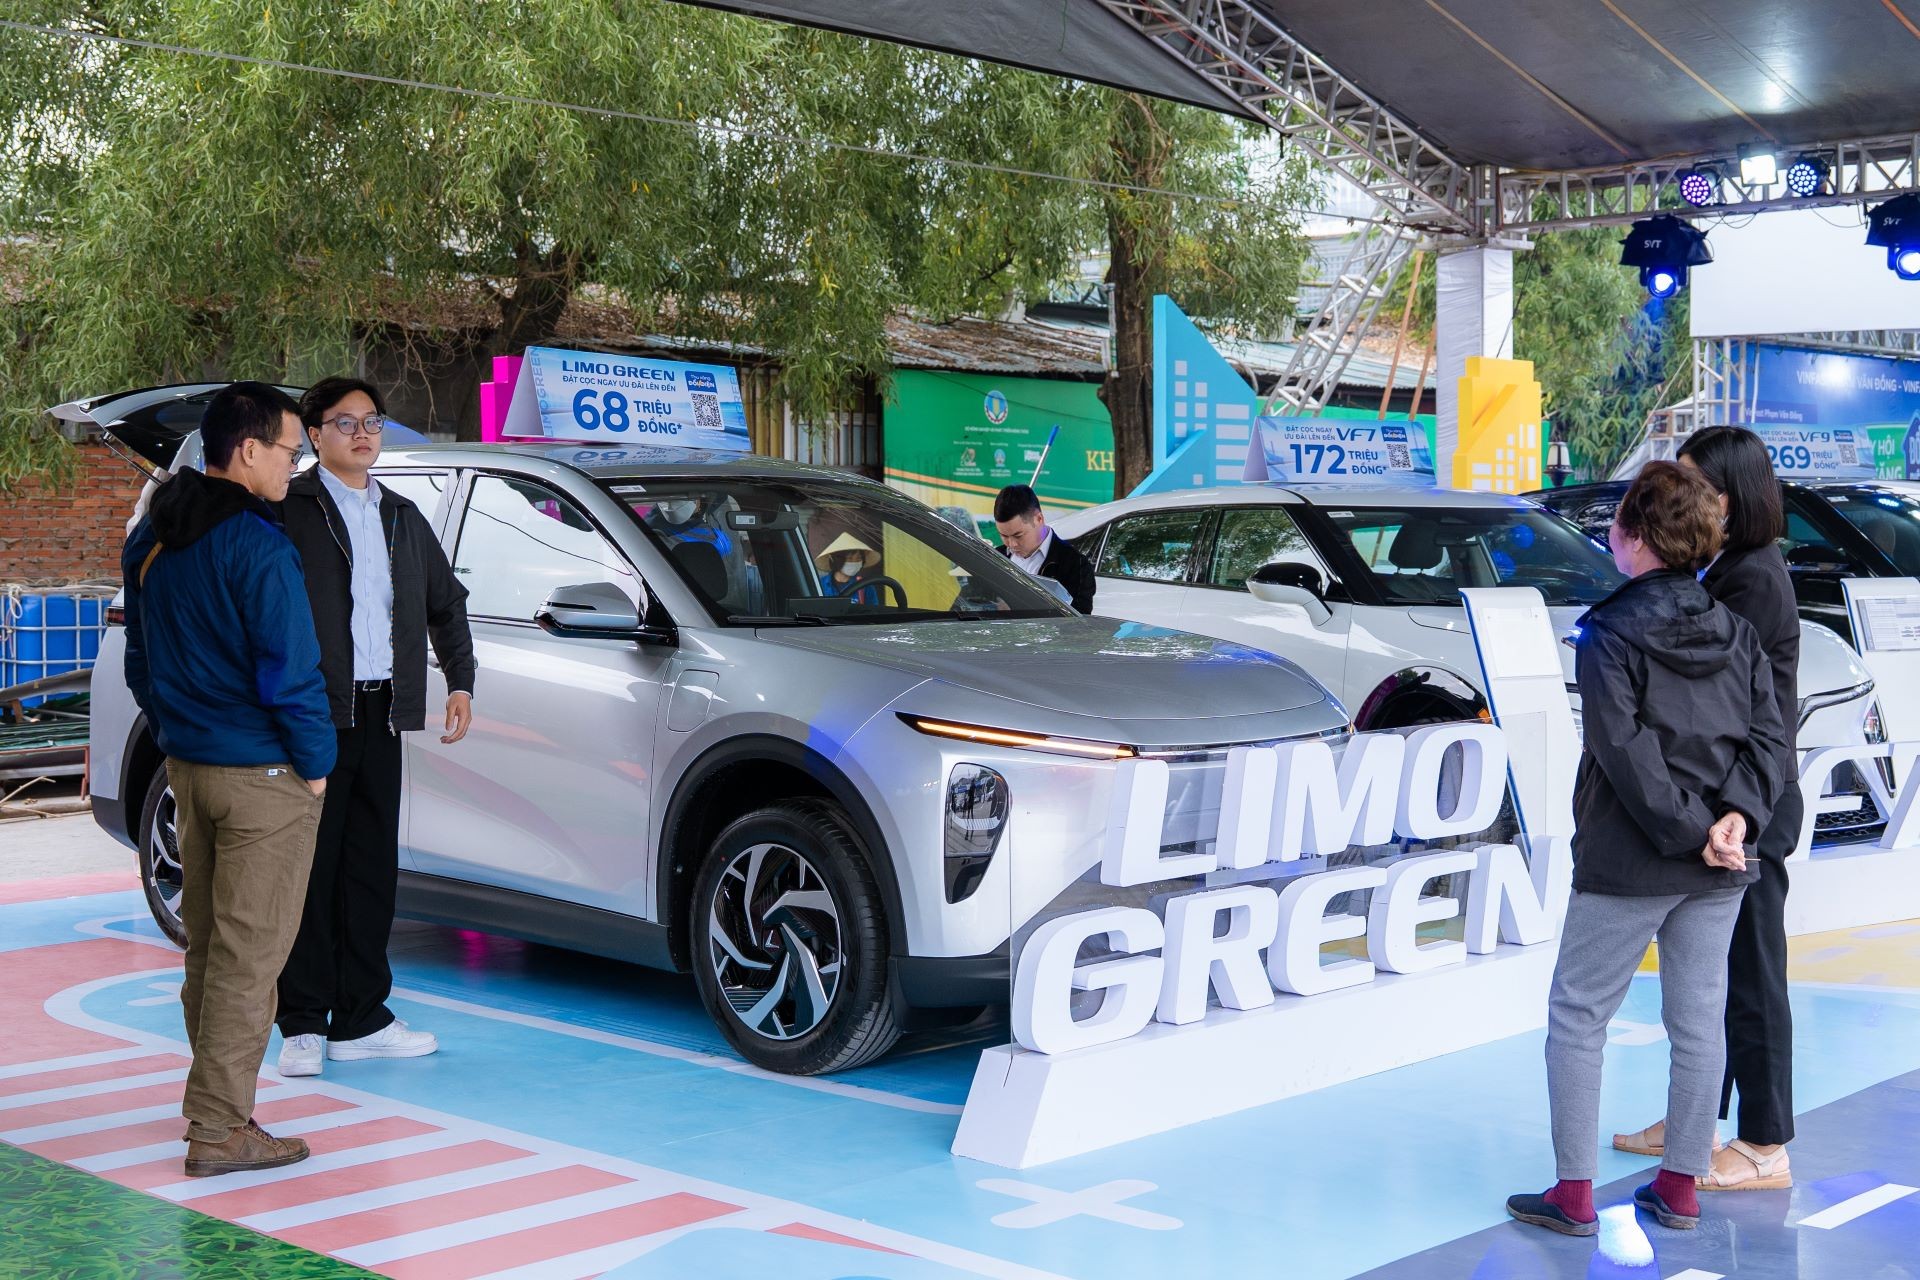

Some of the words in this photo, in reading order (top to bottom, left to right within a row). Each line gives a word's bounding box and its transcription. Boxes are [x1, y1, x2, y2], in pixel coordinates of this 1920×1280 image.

[1883, 216, 1902, 226] SVT
[1643, 239, 1662, 249] SVT
[562, 360, 610, 375] LIMO
[613, 364, 675, 381] GREEN
[562, 375, 579, 385] ĐẶT
[579, 376, 596, 386] CỌC
[597, 378, 617, 387] NGAY
[618, 379, 630, 388] ƯU
[631, 380, 645, 389] ĐÃI
[645, 382, 661, 391] LÊN
[661, 382, 676, 392] ĐẾN
[1903, 379, 1920, 394] VINF
[572, 388, 630, 433] 68
[633, 398, 672, 418] TRIỆU
[1336, 427, 1376, 441] VF7
[1798, 431, 1830, 443] VF9
[1347, 449, 1378, 462] TRIỆU
[1877, 434, 1895, 459] HỘI
[1289, 443, 1347, 475] 172
[1766, 445, 1811, 470] 269
[1100, 722, 1508, 887] LIMO
[1012, 835, 1563, 1055] GREEN
